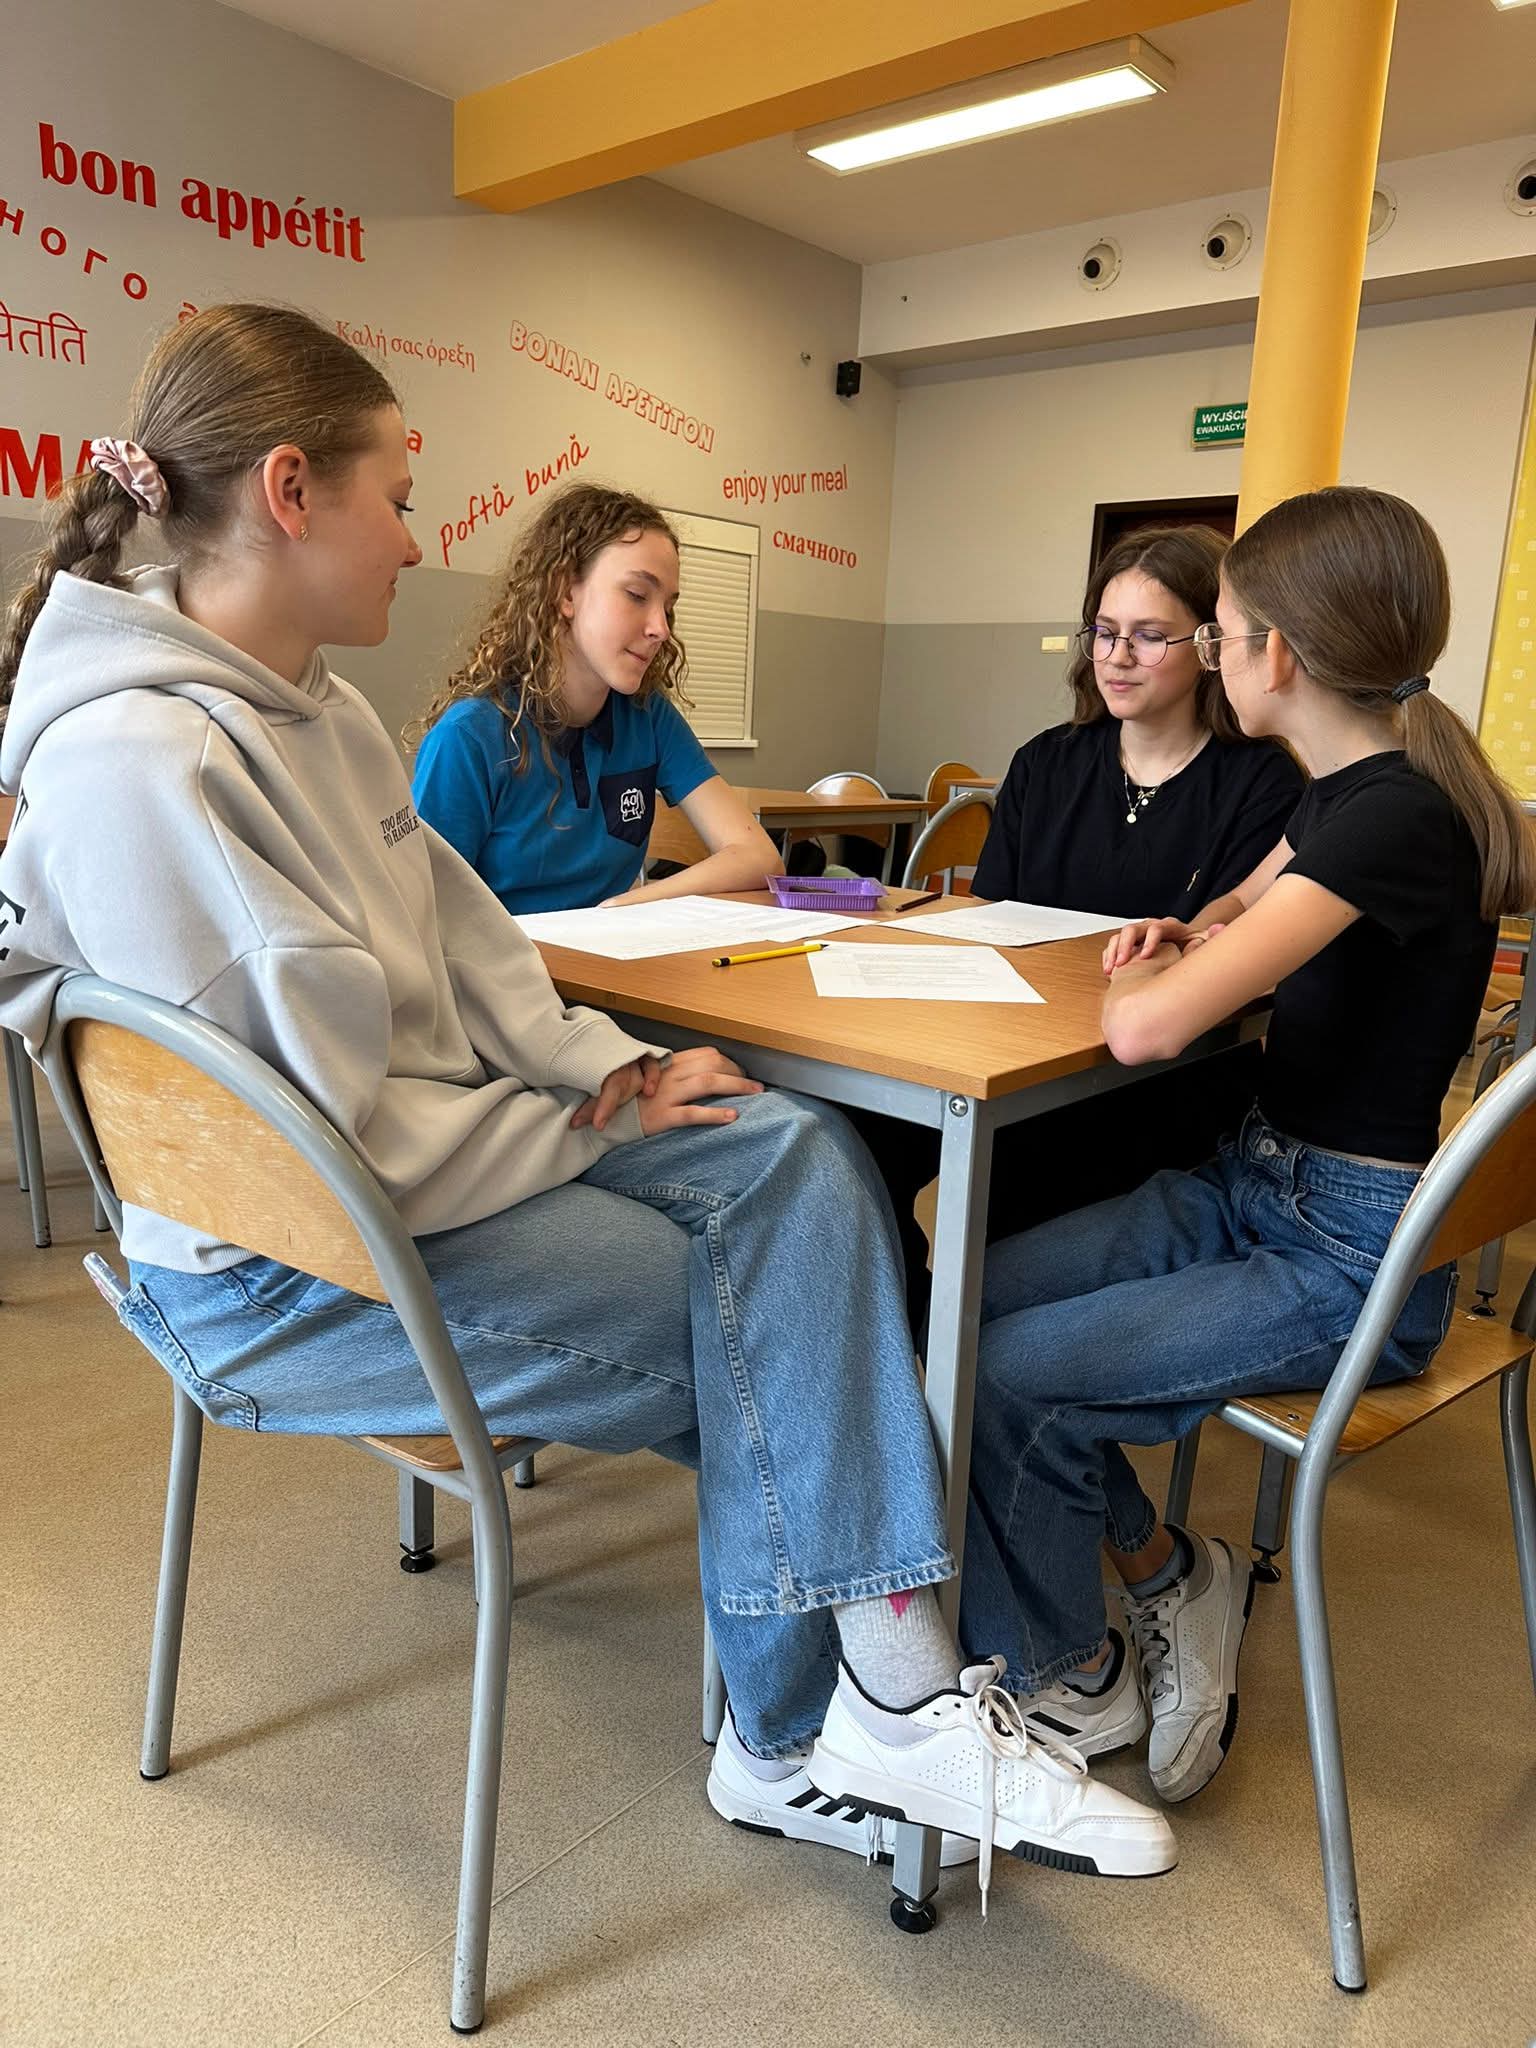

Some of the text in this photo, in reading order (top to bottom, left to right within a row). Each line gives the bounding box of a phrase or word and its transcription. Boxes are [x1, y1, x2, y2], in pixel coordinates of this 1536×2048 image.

[38, 122, 367, 263] bon appétit
[391, 336, 423, 360] σας
[426, 338, 475, 373] όρεξη
[510, 319, 599, 391] BONAN
[440, 433, 590, 568] poftă bună
[722, 463, 848, 506] enjoy your meal
[772, 530, 857, 569] смачного
[380, 804, 410, 835] TOO HOT
[383, 815, 420, 849] TO HANDLE
